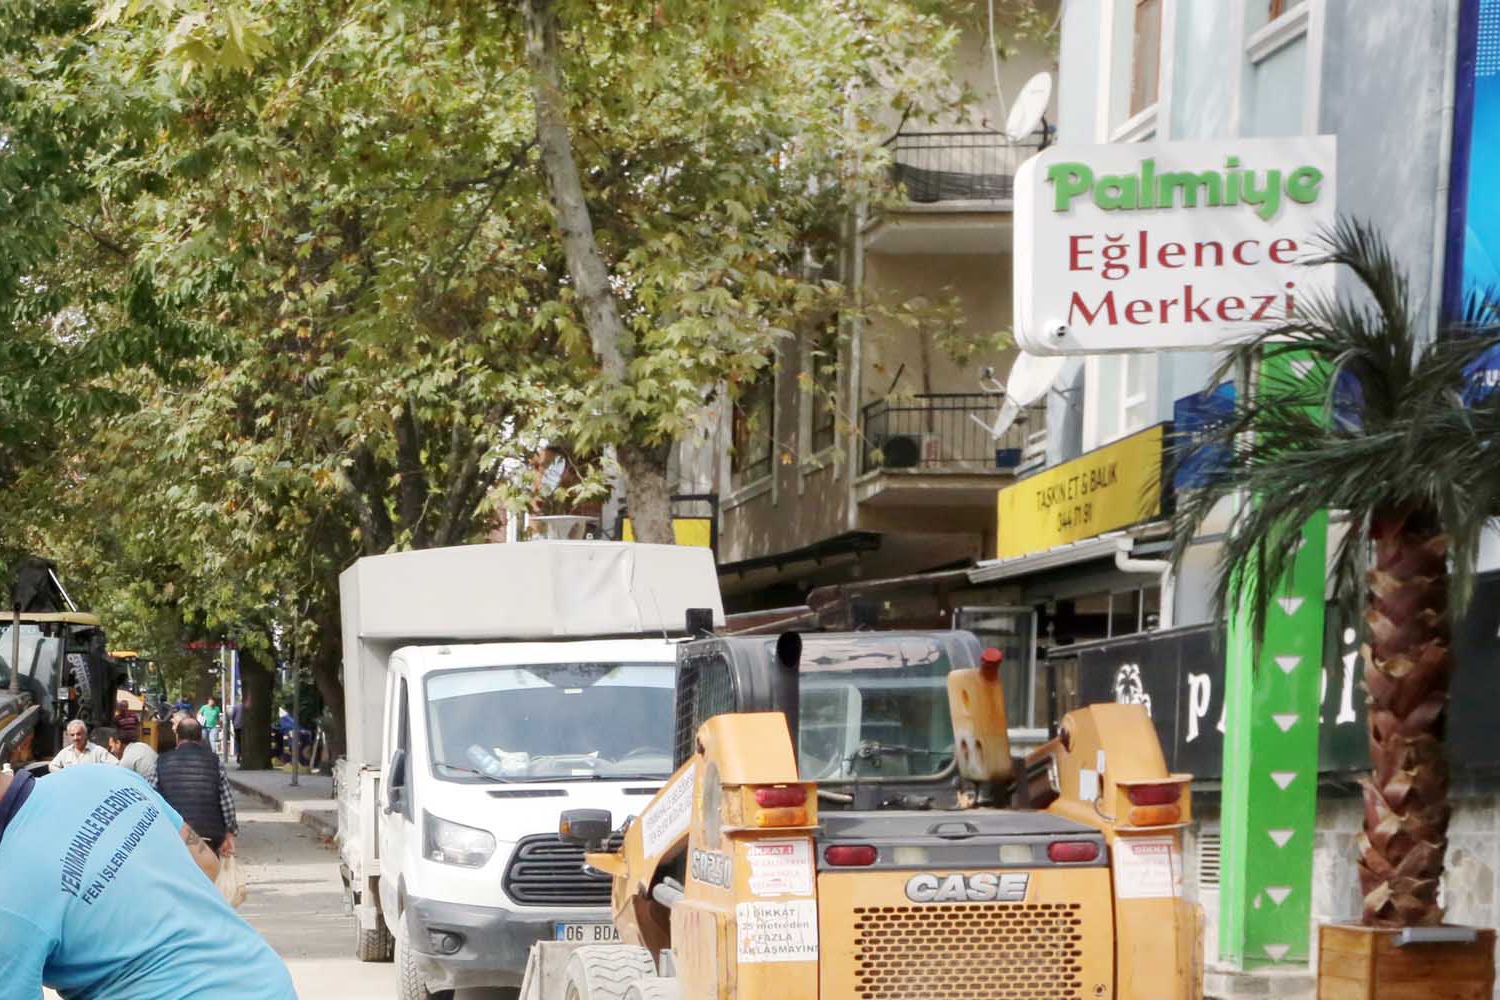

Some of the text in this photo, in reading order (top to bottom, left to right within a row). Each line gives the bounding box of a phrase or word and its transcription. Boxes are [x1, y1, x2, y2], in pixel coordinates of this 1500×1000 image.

[1045, 156, 1324, 221] Palmiye
[1068, 230, 1298, 280] Eğlence
[1068, 282, 1296, 326] Merkezi
[60, 819, 105, 898] YENİMAHALLE
[82, 880, 106, 905] FEN
[97, 848, 129, 881] İŞLERİ
[691, 847, 733, 889] SR250
[905, 872, 1029, 902] CASE
[566, 926, 620, 941] 06 BDA
[758, 934, 793, 942] FAZLA
